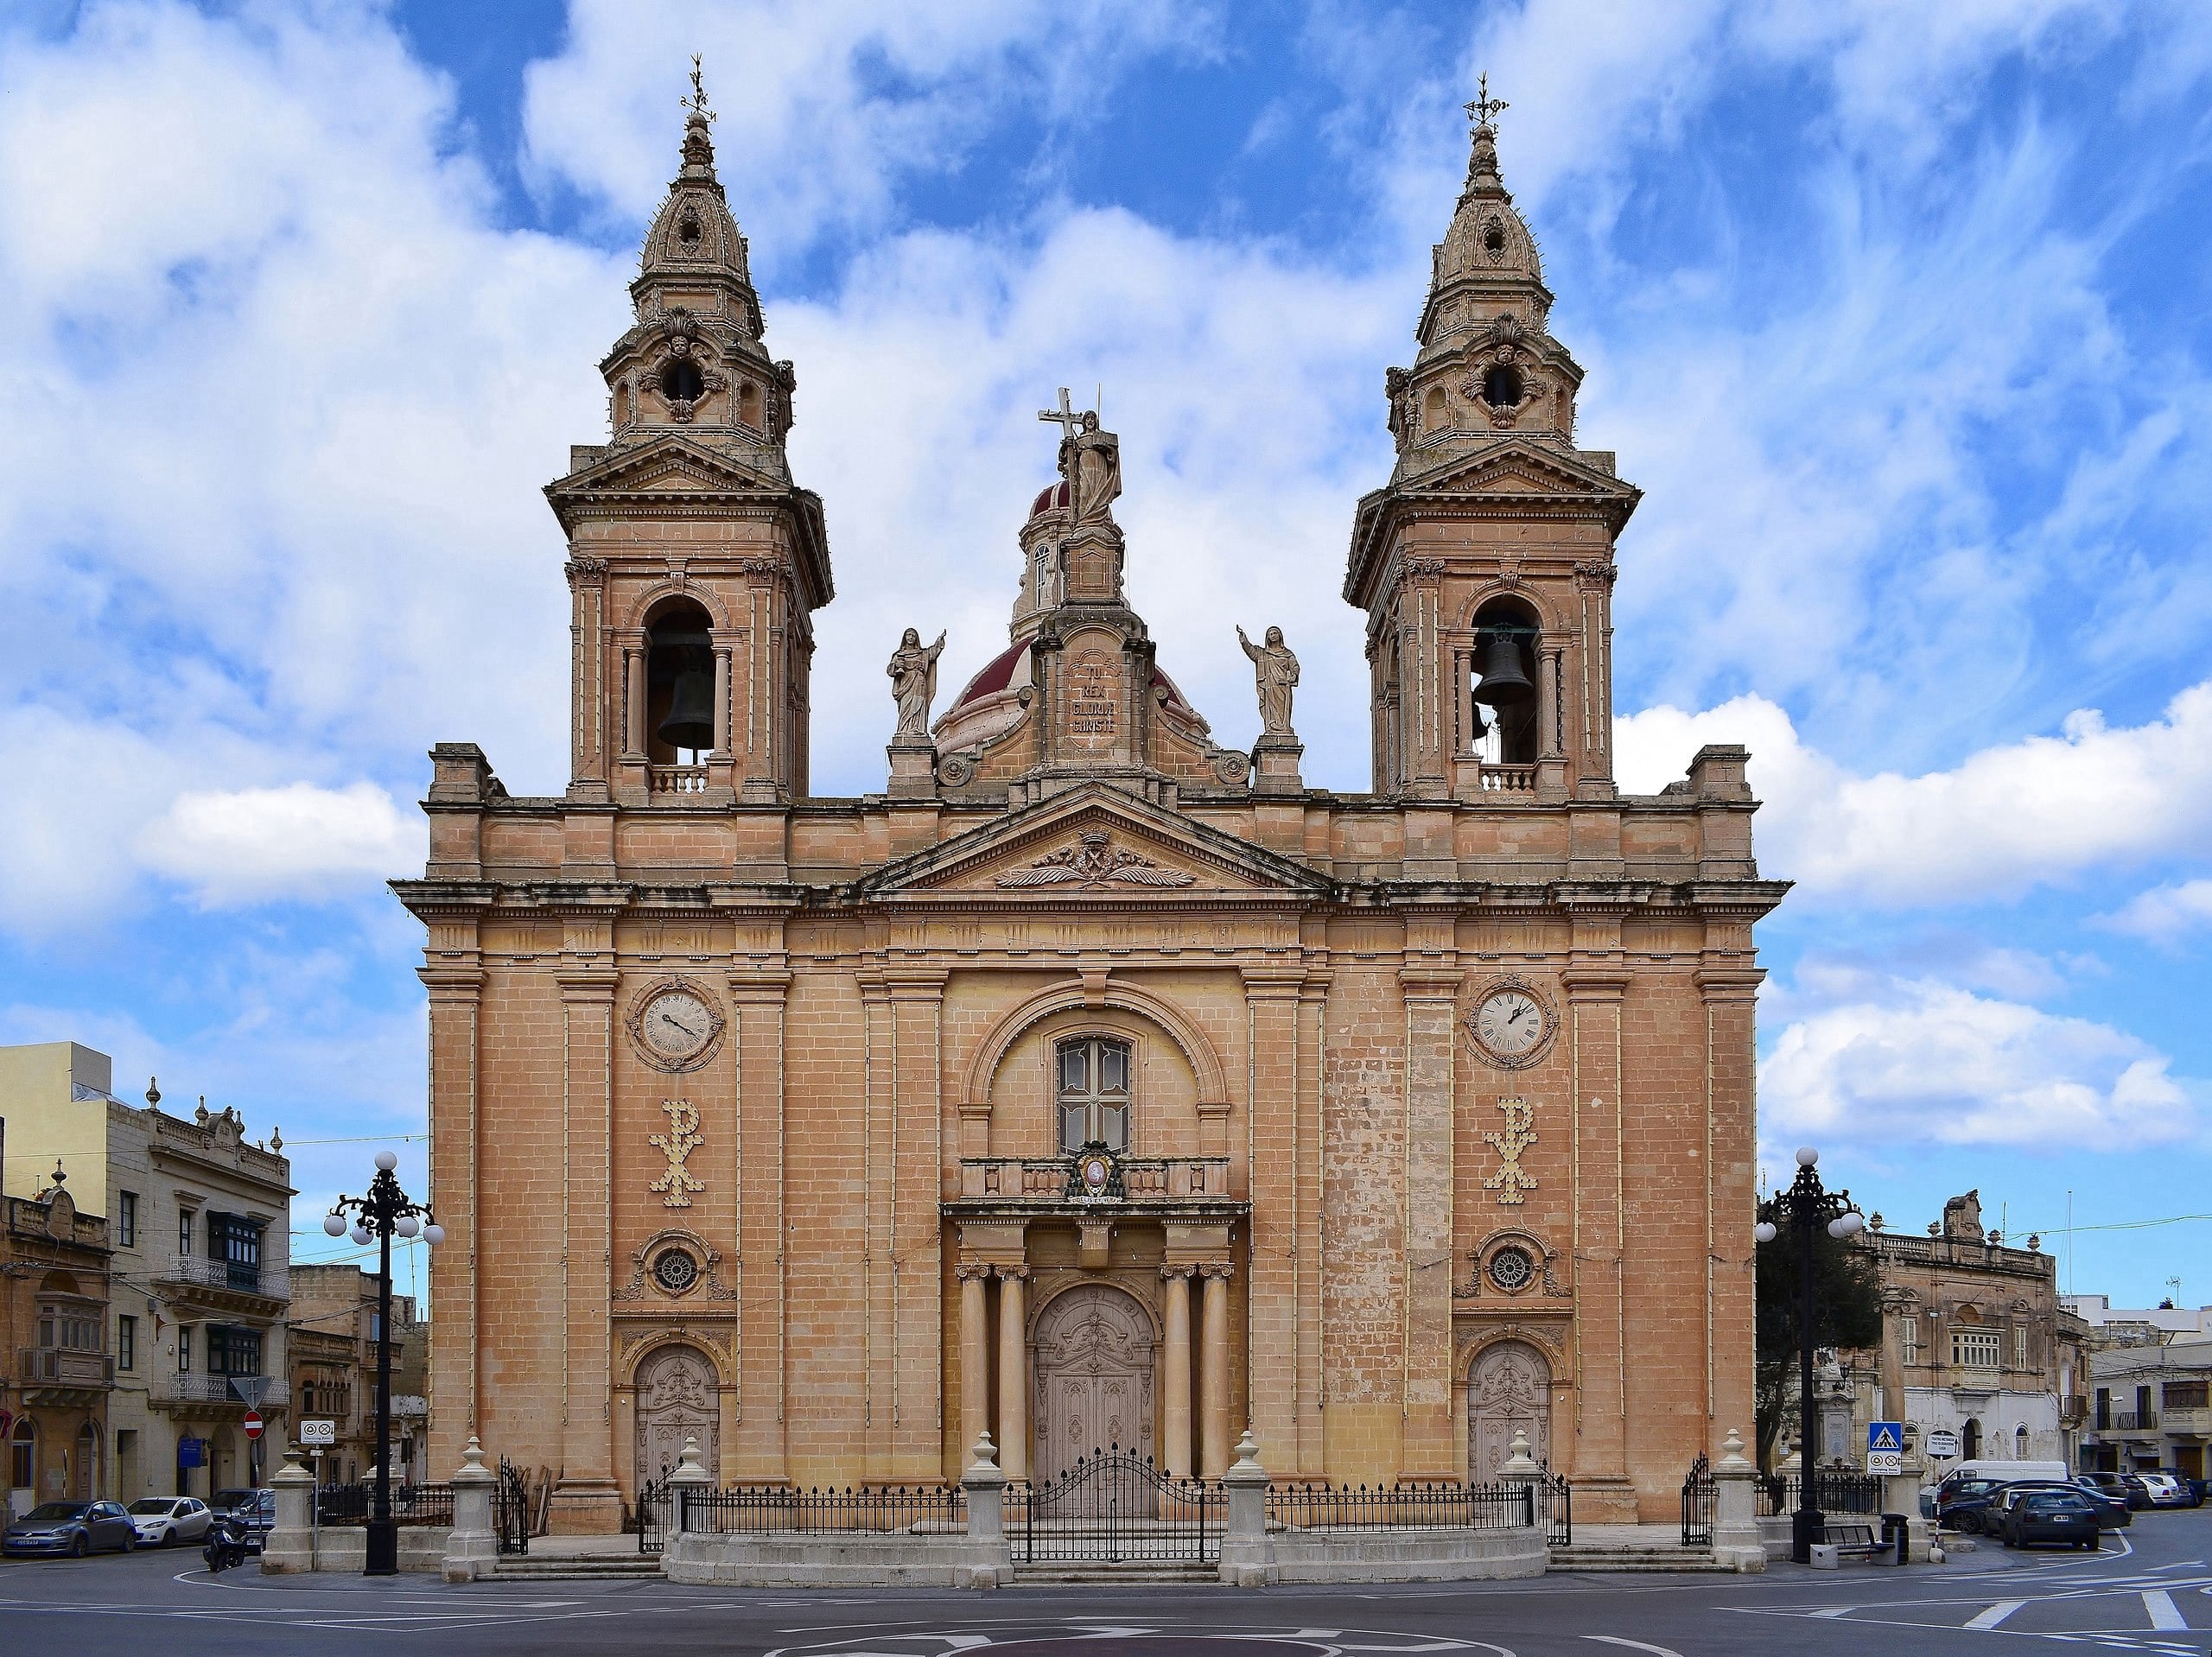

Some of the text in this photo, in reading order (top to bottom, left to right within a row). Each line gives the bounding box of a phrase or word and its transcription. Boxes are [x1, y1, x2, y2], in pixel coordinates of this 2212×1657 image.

[1086, 667, 1102, 680] TU
[1082, 686, 1105, 698] REX
[1072, 720, 1115, 733] CHRISTE
